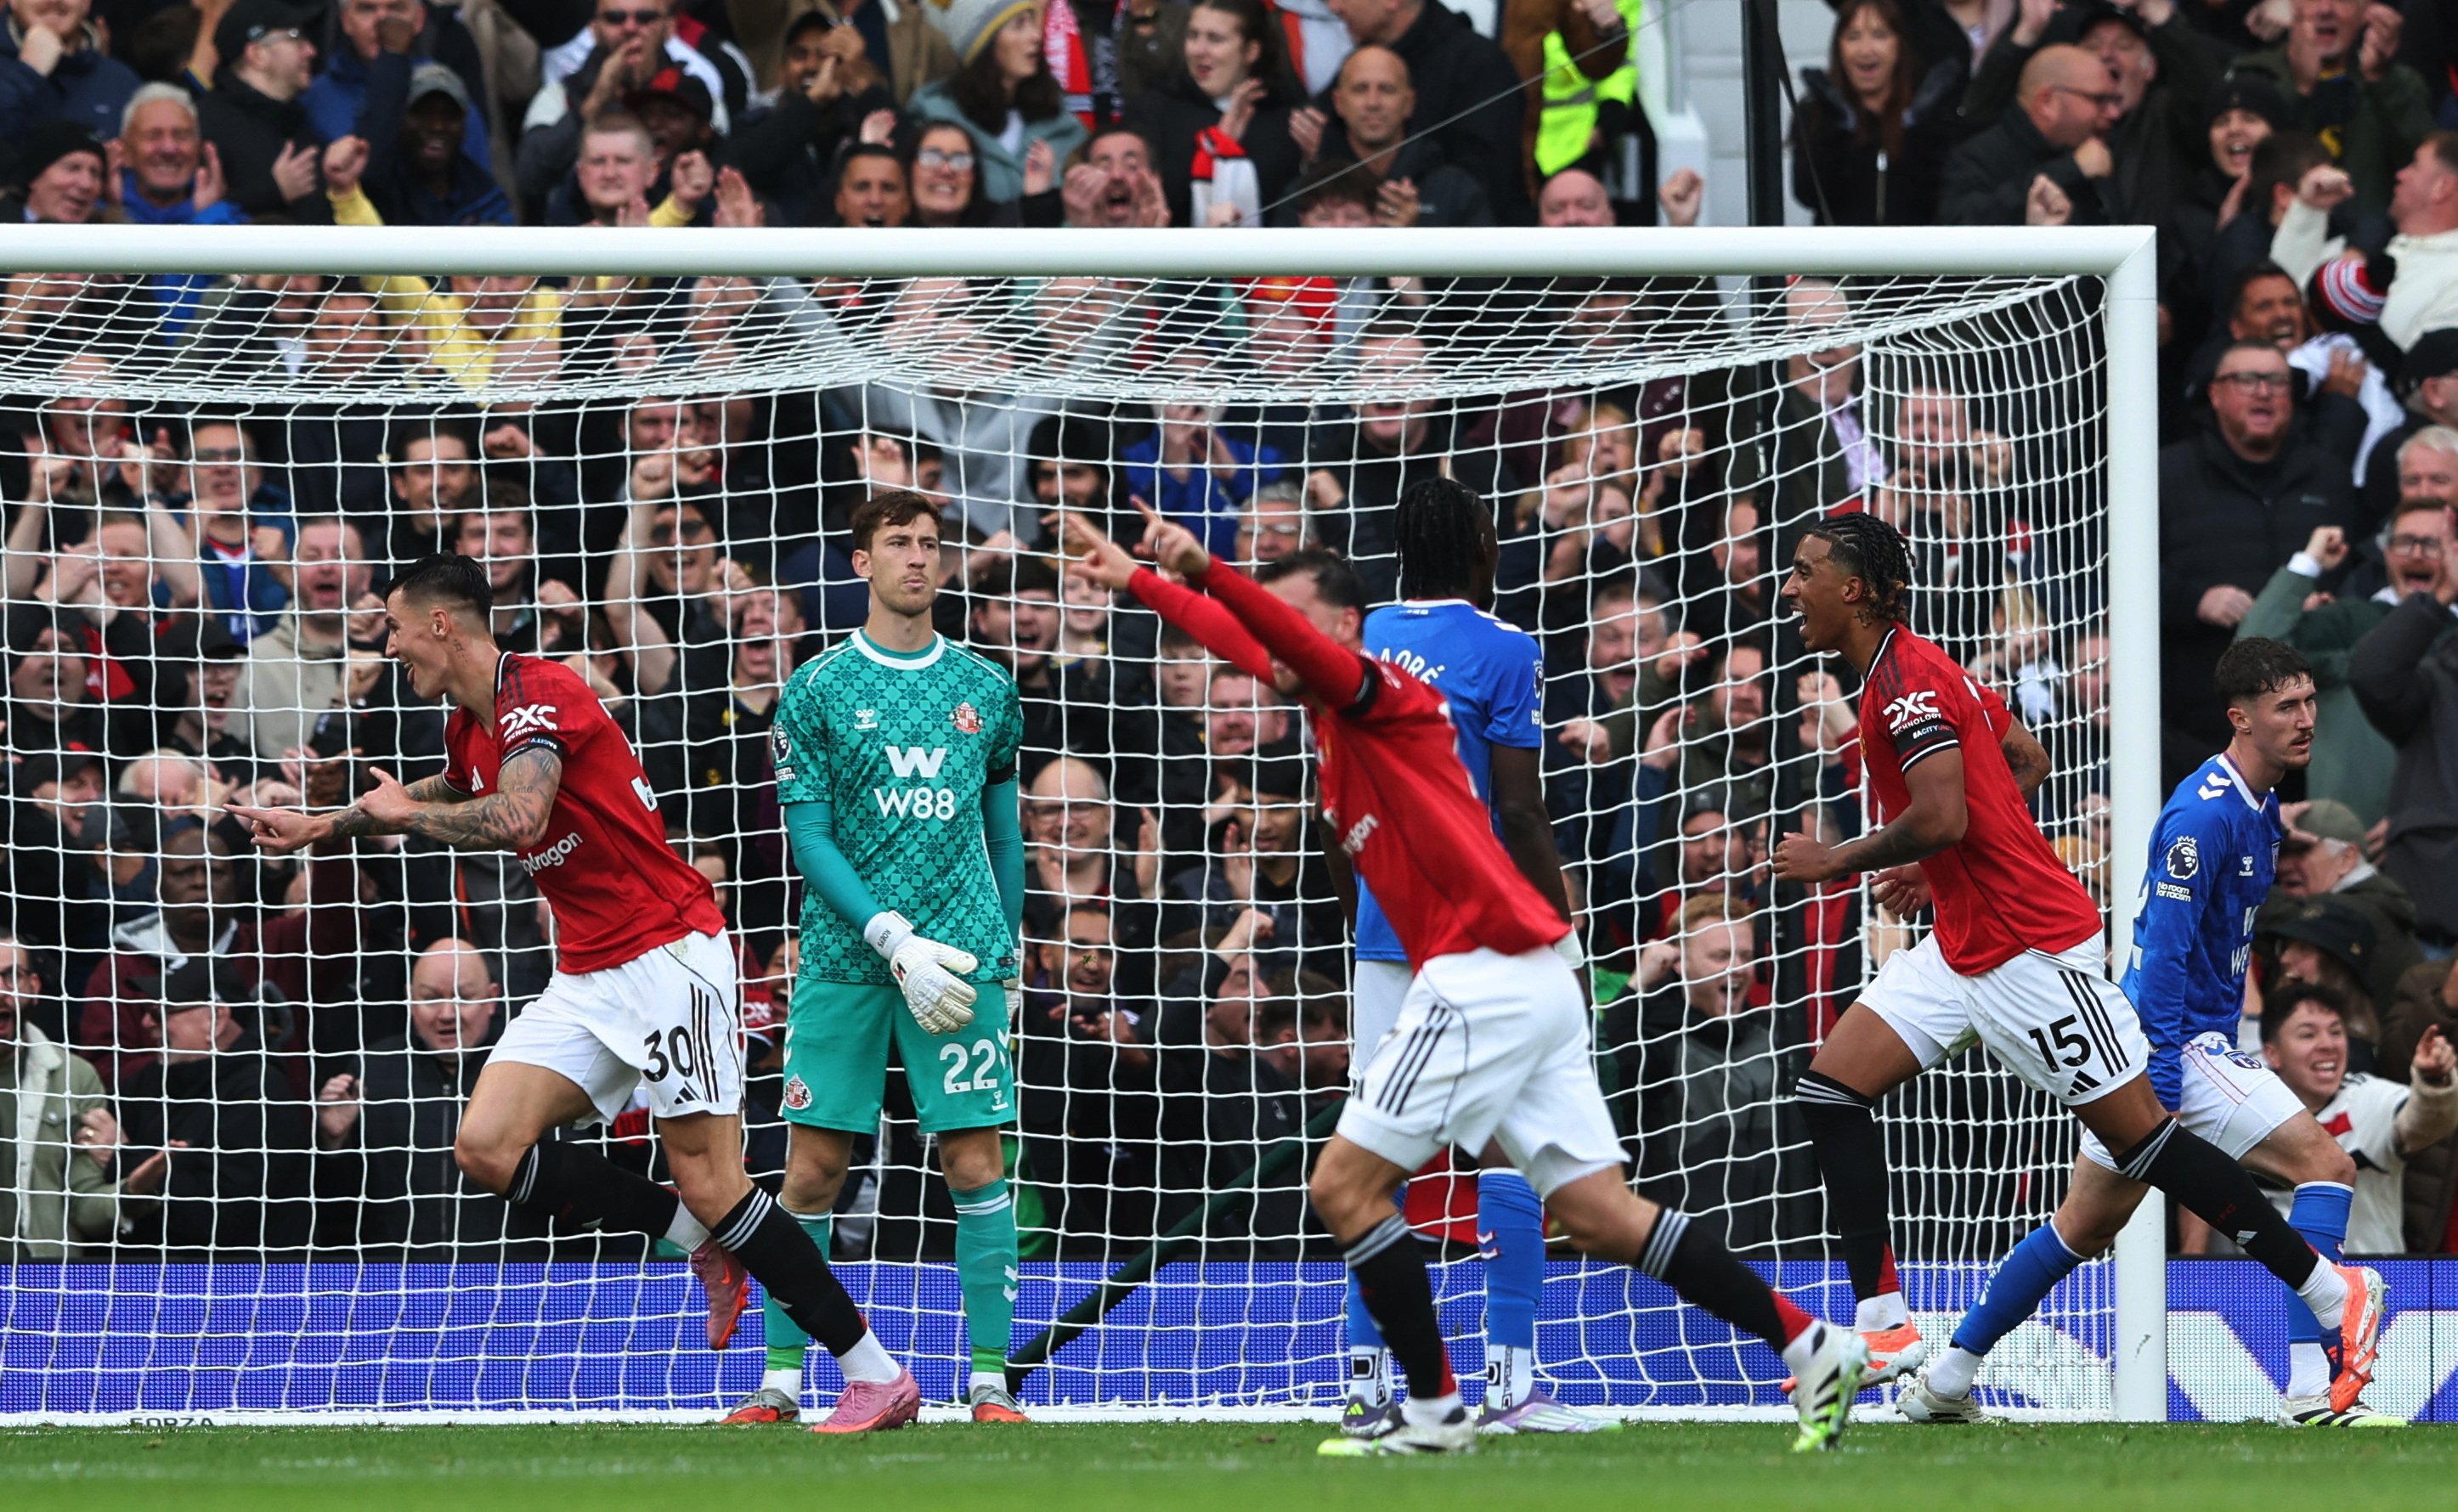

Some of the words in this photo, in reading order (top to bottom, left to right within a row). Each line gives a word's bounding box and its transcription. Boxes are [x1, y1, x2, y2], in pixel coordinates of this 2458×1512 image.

[873, 787, 956, 821] W88
[642, 1025, 694, 1083] 30
[940, 1039, 997, 1094] 22
[2028, 1013, 2091, 1073] 15
